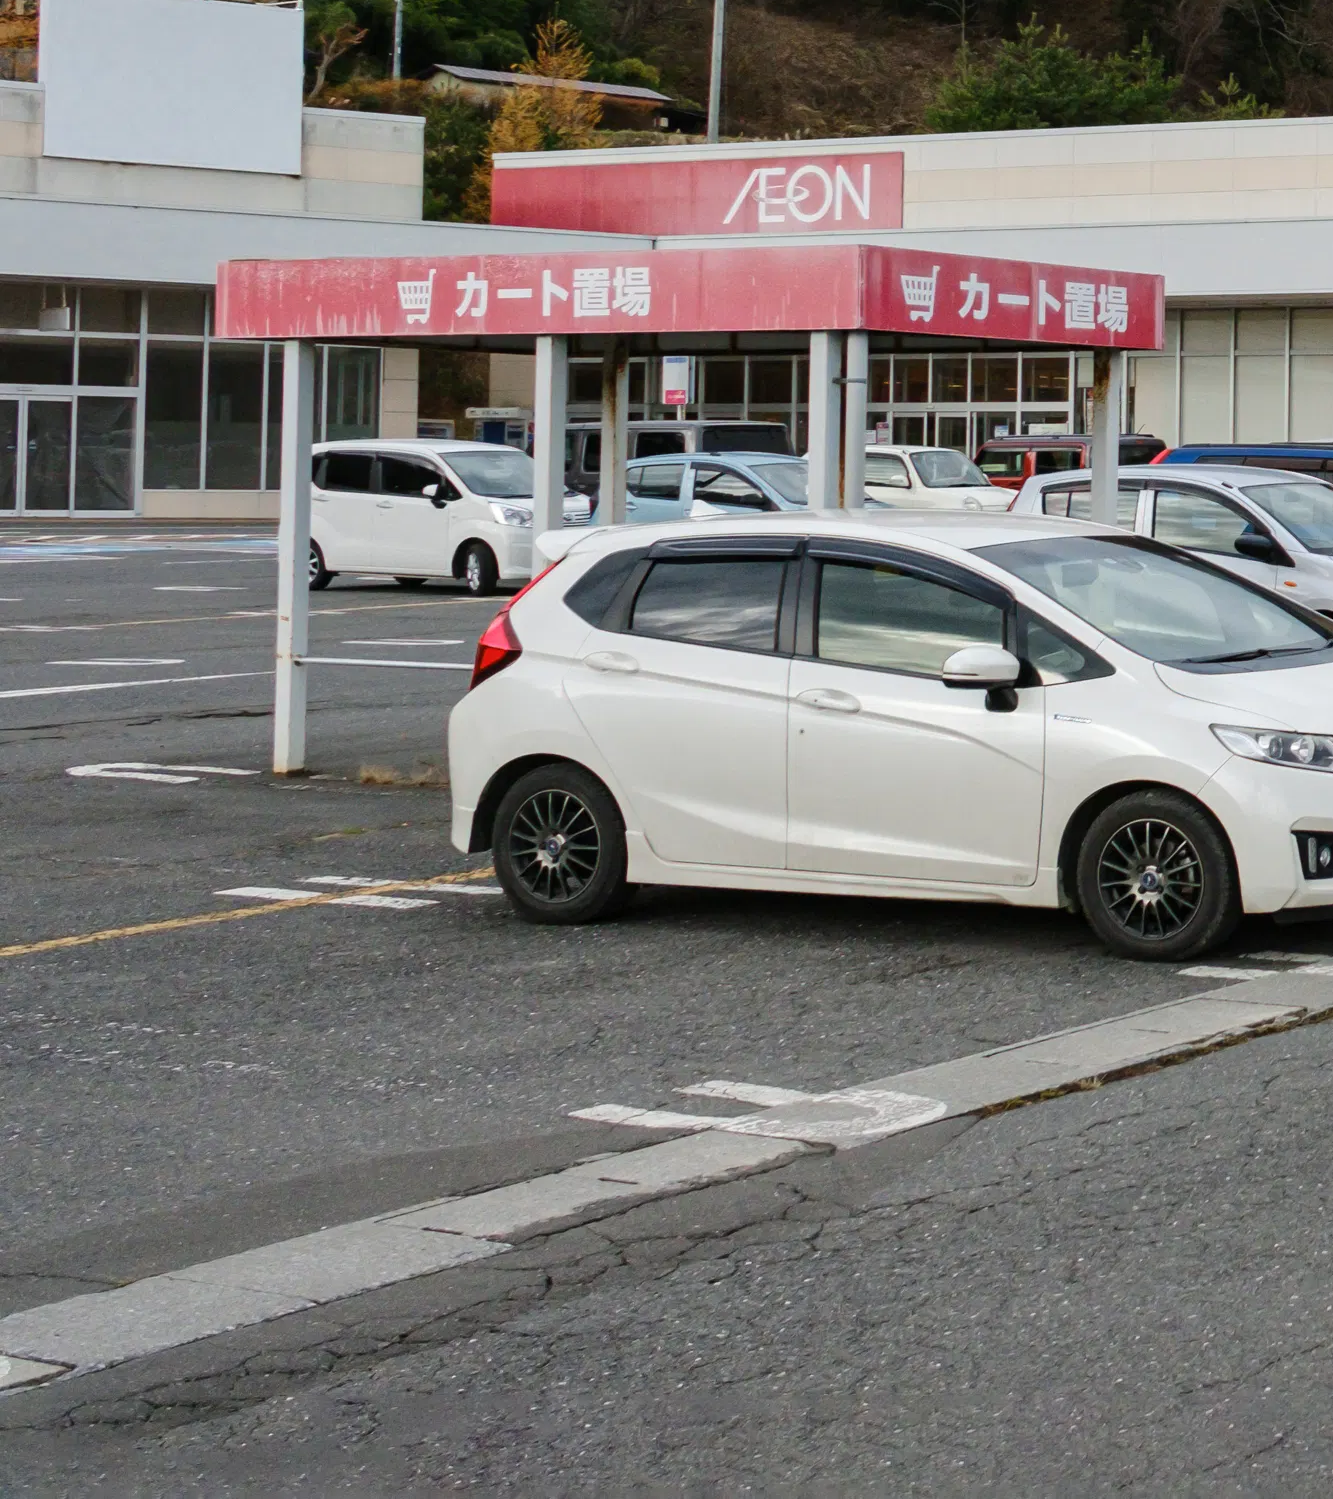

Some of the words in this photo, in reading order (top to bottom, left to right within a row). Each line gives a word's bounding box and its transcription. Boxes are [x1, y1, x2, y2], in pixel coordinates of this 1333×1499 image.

[455, 266, 653, 320] カート置場
[958, 270, 1131, 334] カート置場
